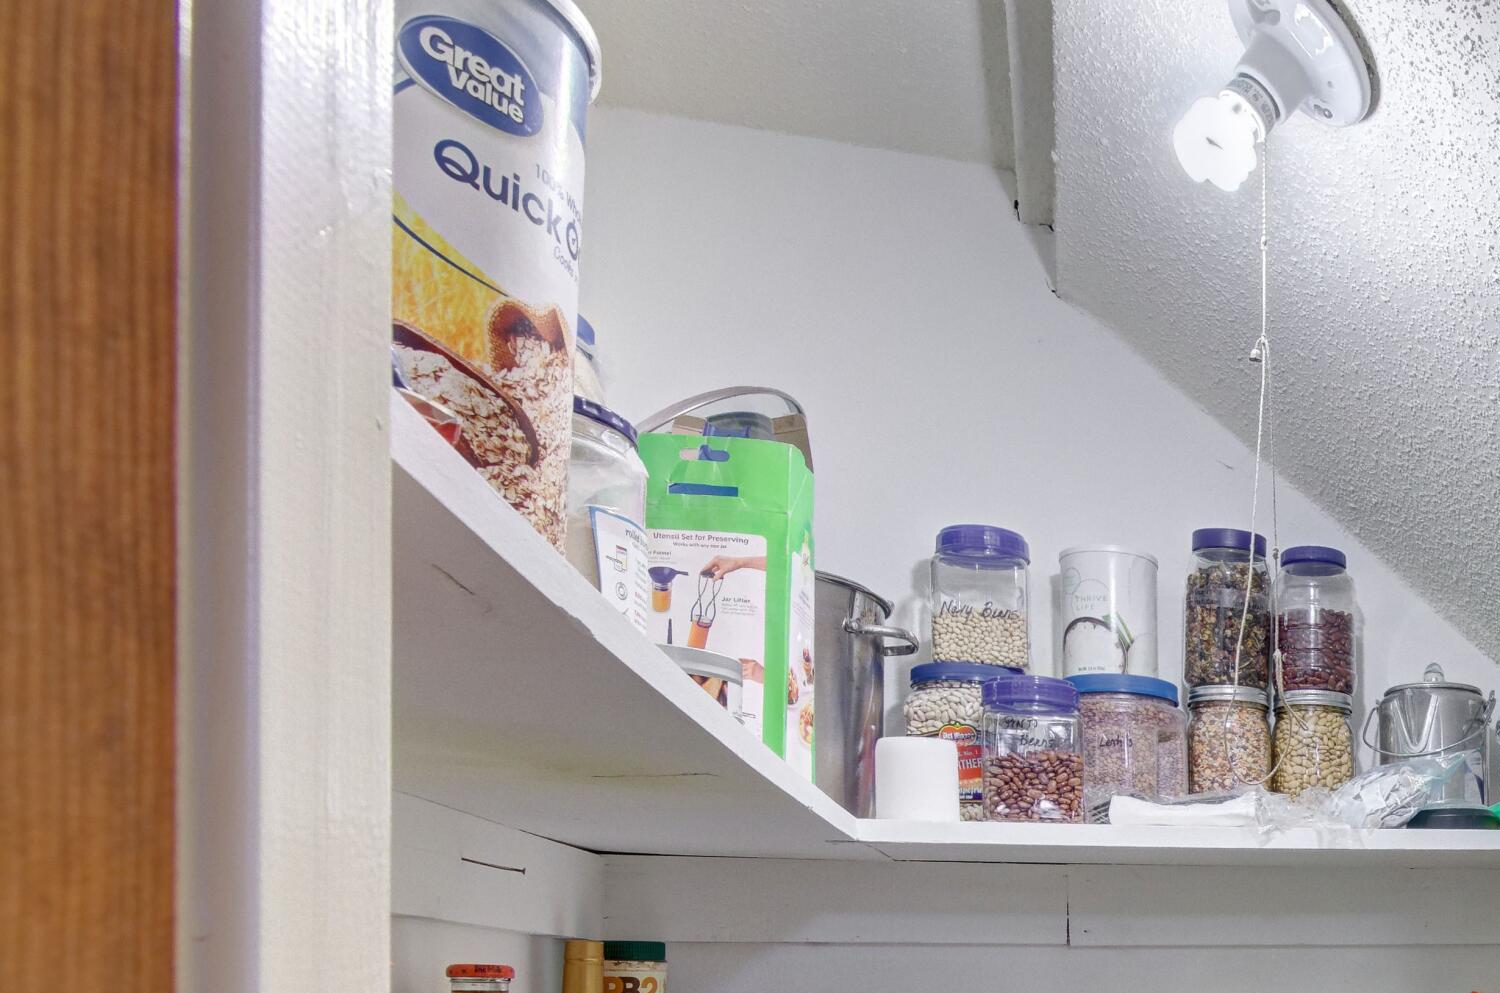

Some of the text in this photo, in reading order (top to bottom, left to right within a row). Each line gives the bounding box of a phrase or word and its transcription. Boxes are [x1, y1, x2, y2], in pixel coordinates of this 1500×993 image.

[419, 26, 525, 106] Great
[447, 64, 524, 124] Value
[433, 139, 561, 245] Quick
[653, 532, 680, 541] Utensil
[681, 533, 693, 541] Set
[707, 534, 749, 545] Preserving
[940, 600, 973, 624] Navy
[1075, 594, 1107, 602] THRIVE
